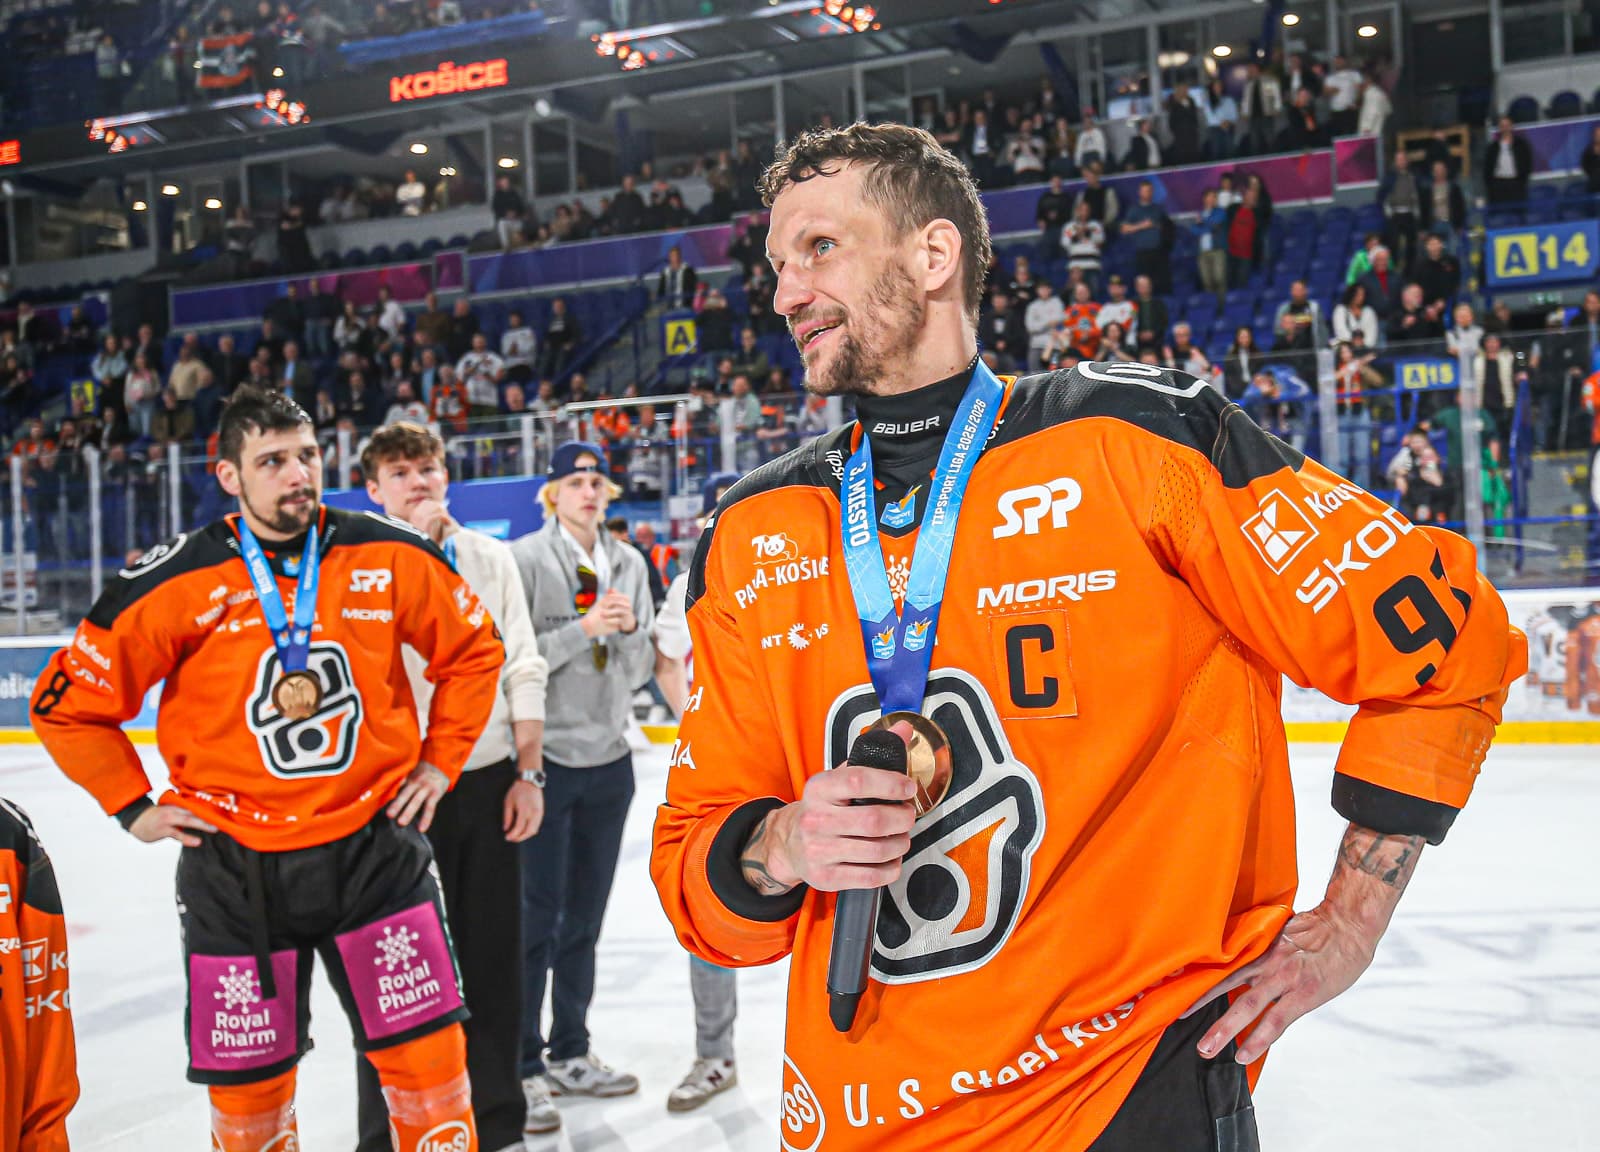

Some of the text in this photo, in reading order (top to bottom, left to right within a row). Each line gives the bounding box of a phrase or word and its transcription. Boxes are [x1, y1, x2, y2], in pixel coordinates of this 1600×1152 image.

[389, 58, 509, 102] KOŠICE
[931, 476, 957, 527] TIPSPORT
[948, 451, 967, 474] LIGA
[993, 477, 1082, 539] SPP
[847, 478, 871, 547] MIESTO
[349, 568, 393, 593] SPP
[977, 569, 1117, 609] MORIS
[1005, 623, 1058, 709] C
[378, 959, 431, 994] Royal
[378, 979, 440, 1014] Pharm
[211, 1029, 276, 1047] Pharm
[215, 1008, 270, 1033] Royal
[951, 1033, 1060, 1098] Steel
